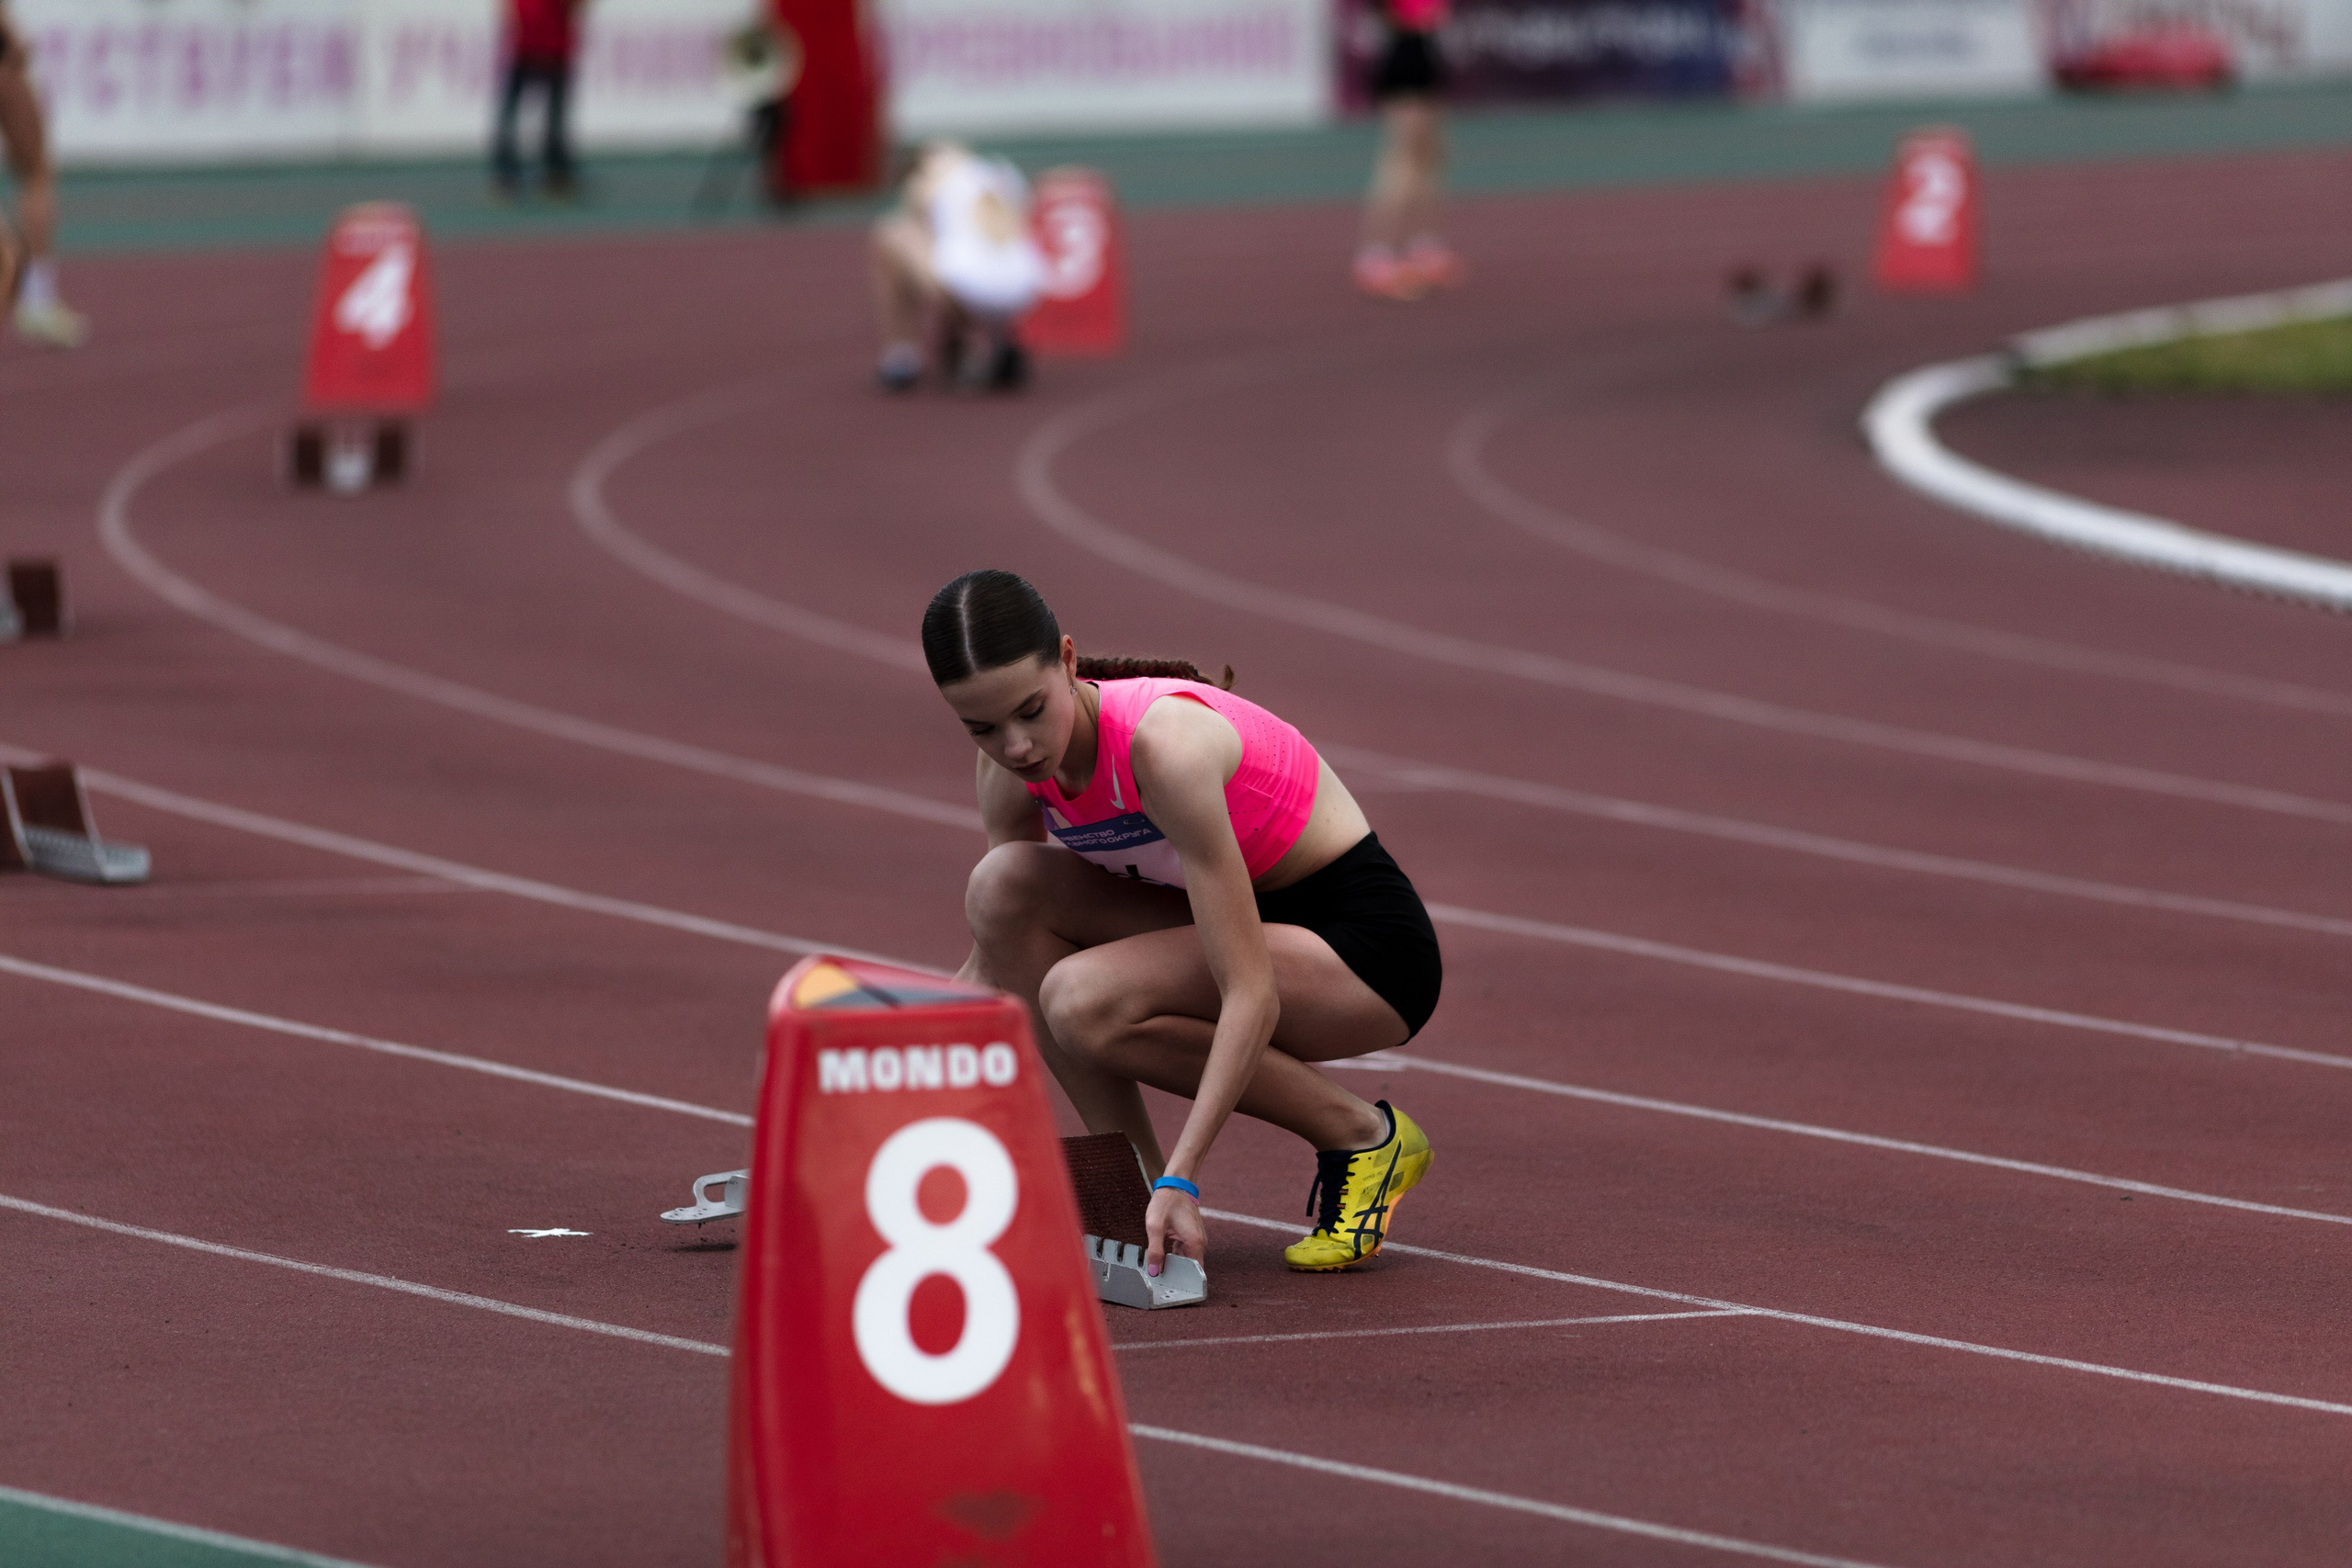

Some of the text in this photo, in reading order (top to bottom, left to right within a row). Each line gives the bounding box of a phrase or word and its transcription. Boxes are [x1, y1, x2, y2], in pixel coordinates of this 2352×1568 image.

[1895, 155, 1965, 244] 2
[335, 243, 413, 348] 4
[1040, 204, 1105, 298] 3
[1106, 829, 1152, 842] ОКРУГА
[818, 1042, 1018, 1094] MONDO
[853, 1116, 1020, 1405] 8
